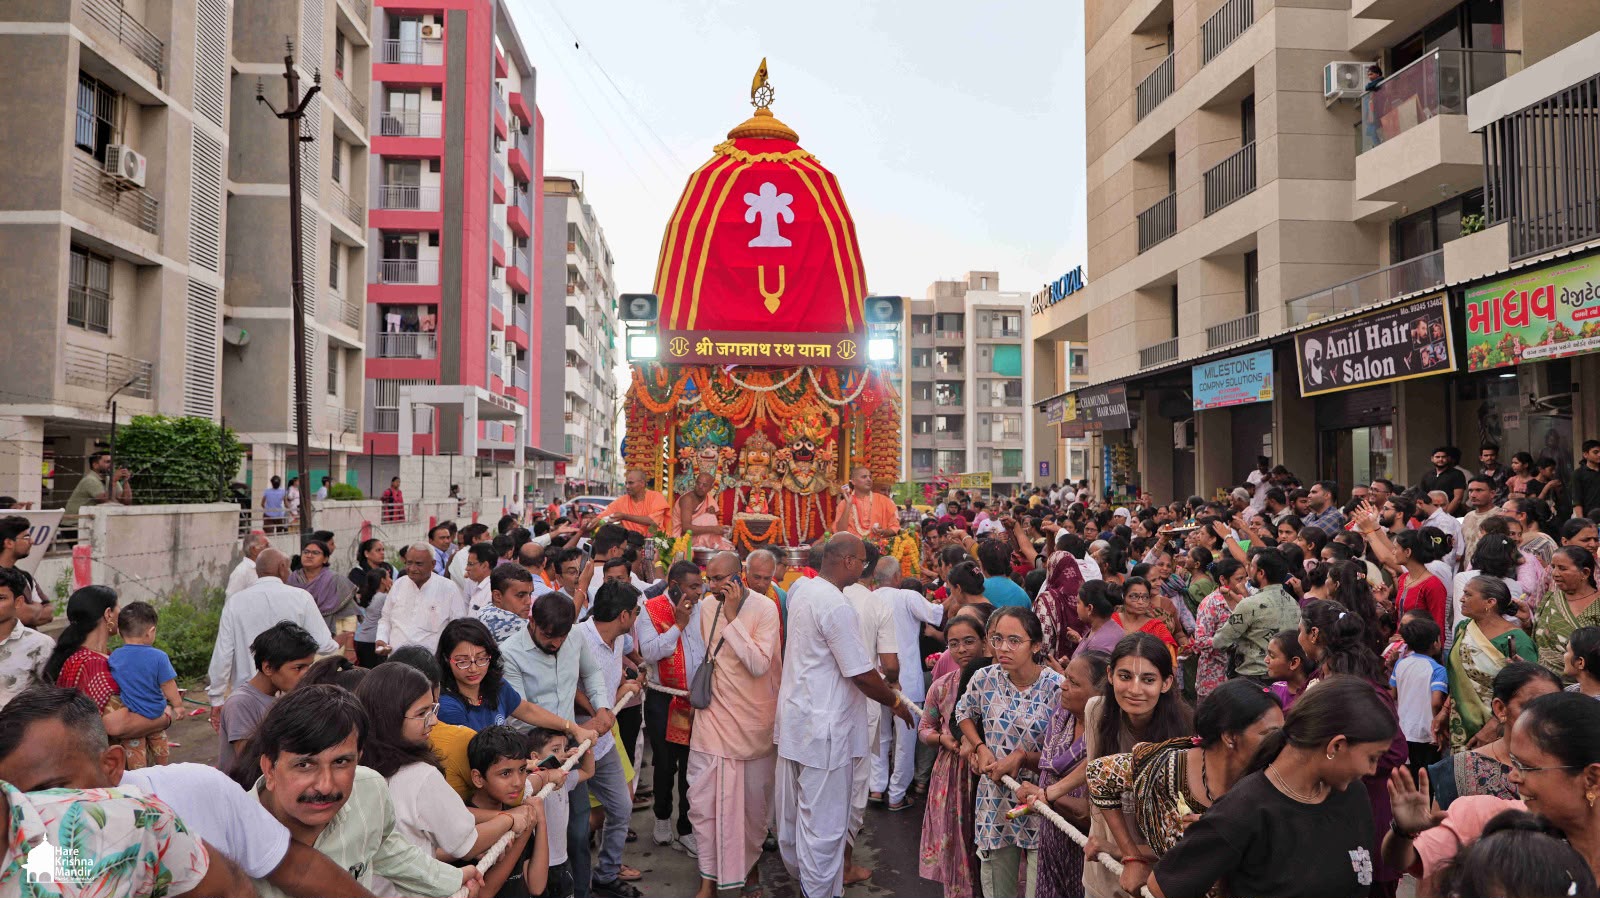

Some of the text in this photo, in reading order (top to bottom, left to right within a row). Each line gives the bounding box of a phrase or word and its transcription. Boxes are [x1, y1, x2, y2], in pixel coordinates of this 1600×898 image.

[1051, 265, 1084, 304] ROYAL
[1467, 285, 1556, 335] માધવ
[695, 337, 832, 358] श्री जगन्नाथ रथ यात्रा
[1326, 320, 1409, 360] Anil Hair
[1204, 358, 1256, 380] MILESTONE
[1226, 372, 1263, 387] SOLUTIONS
[1342, 355, 1396, 383] Salon
[1080, 394, 1110, 408] CHAMUNDA
[1096, 402, 1126, 417] HAIR SALON
